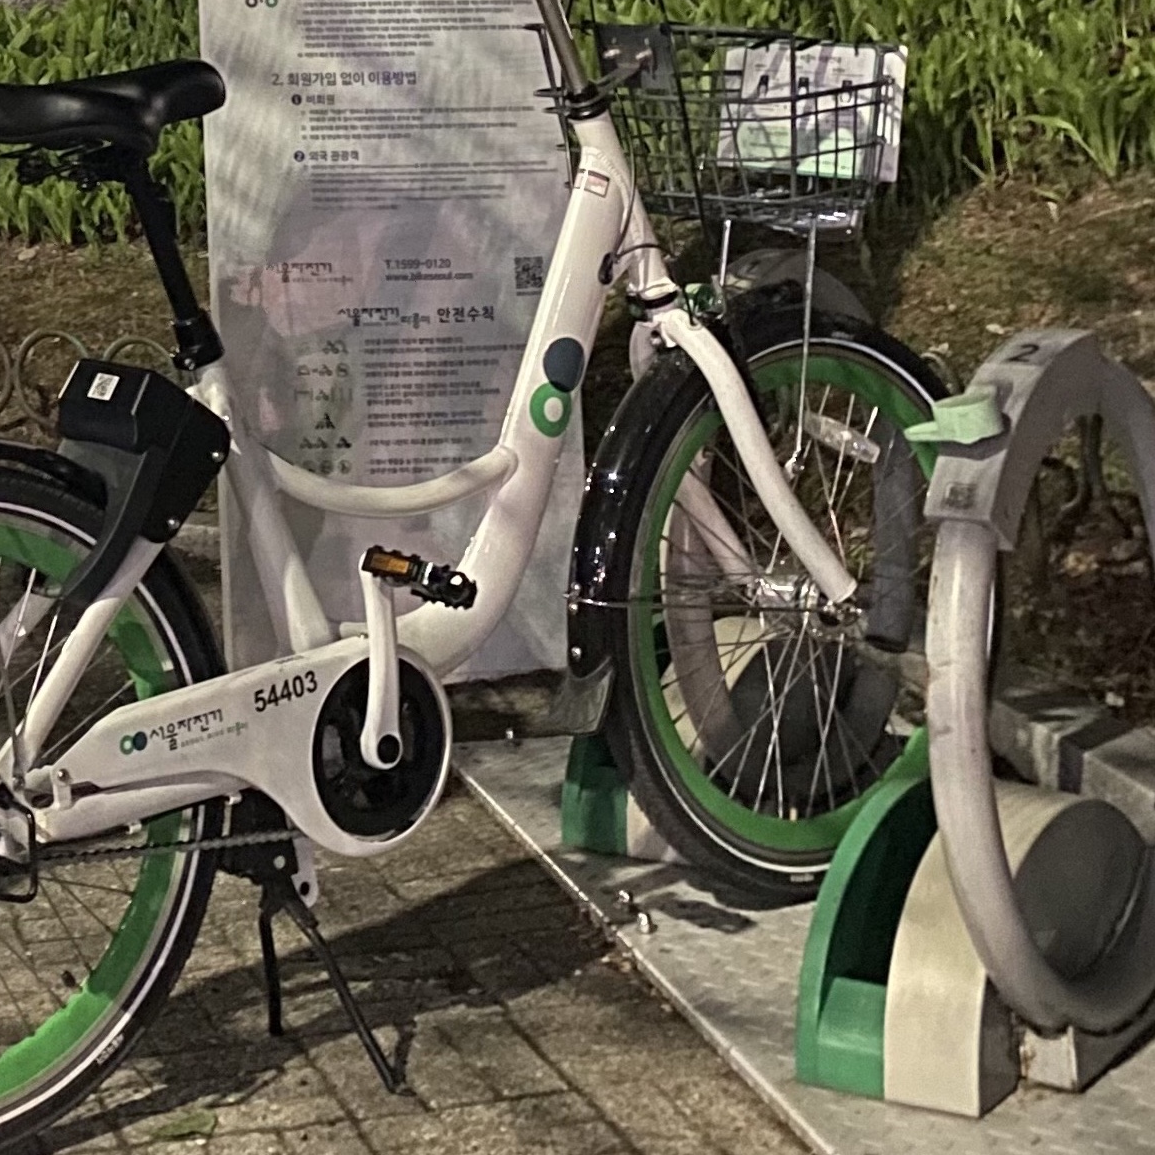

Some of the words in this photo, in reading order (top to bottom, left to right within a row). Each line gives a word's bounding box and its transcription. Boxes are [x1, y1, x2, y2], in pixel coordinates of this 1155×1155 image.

[287, 72, 337, 87] 회원가입
[340, 71, 365, 86] 없이
[368, 70, 418, 86] 이용방법
[436, 305, 495, 323] 안전수칙
[1006, 343, 1040, 363] 2
[253, 670, 319, 713] 54403
